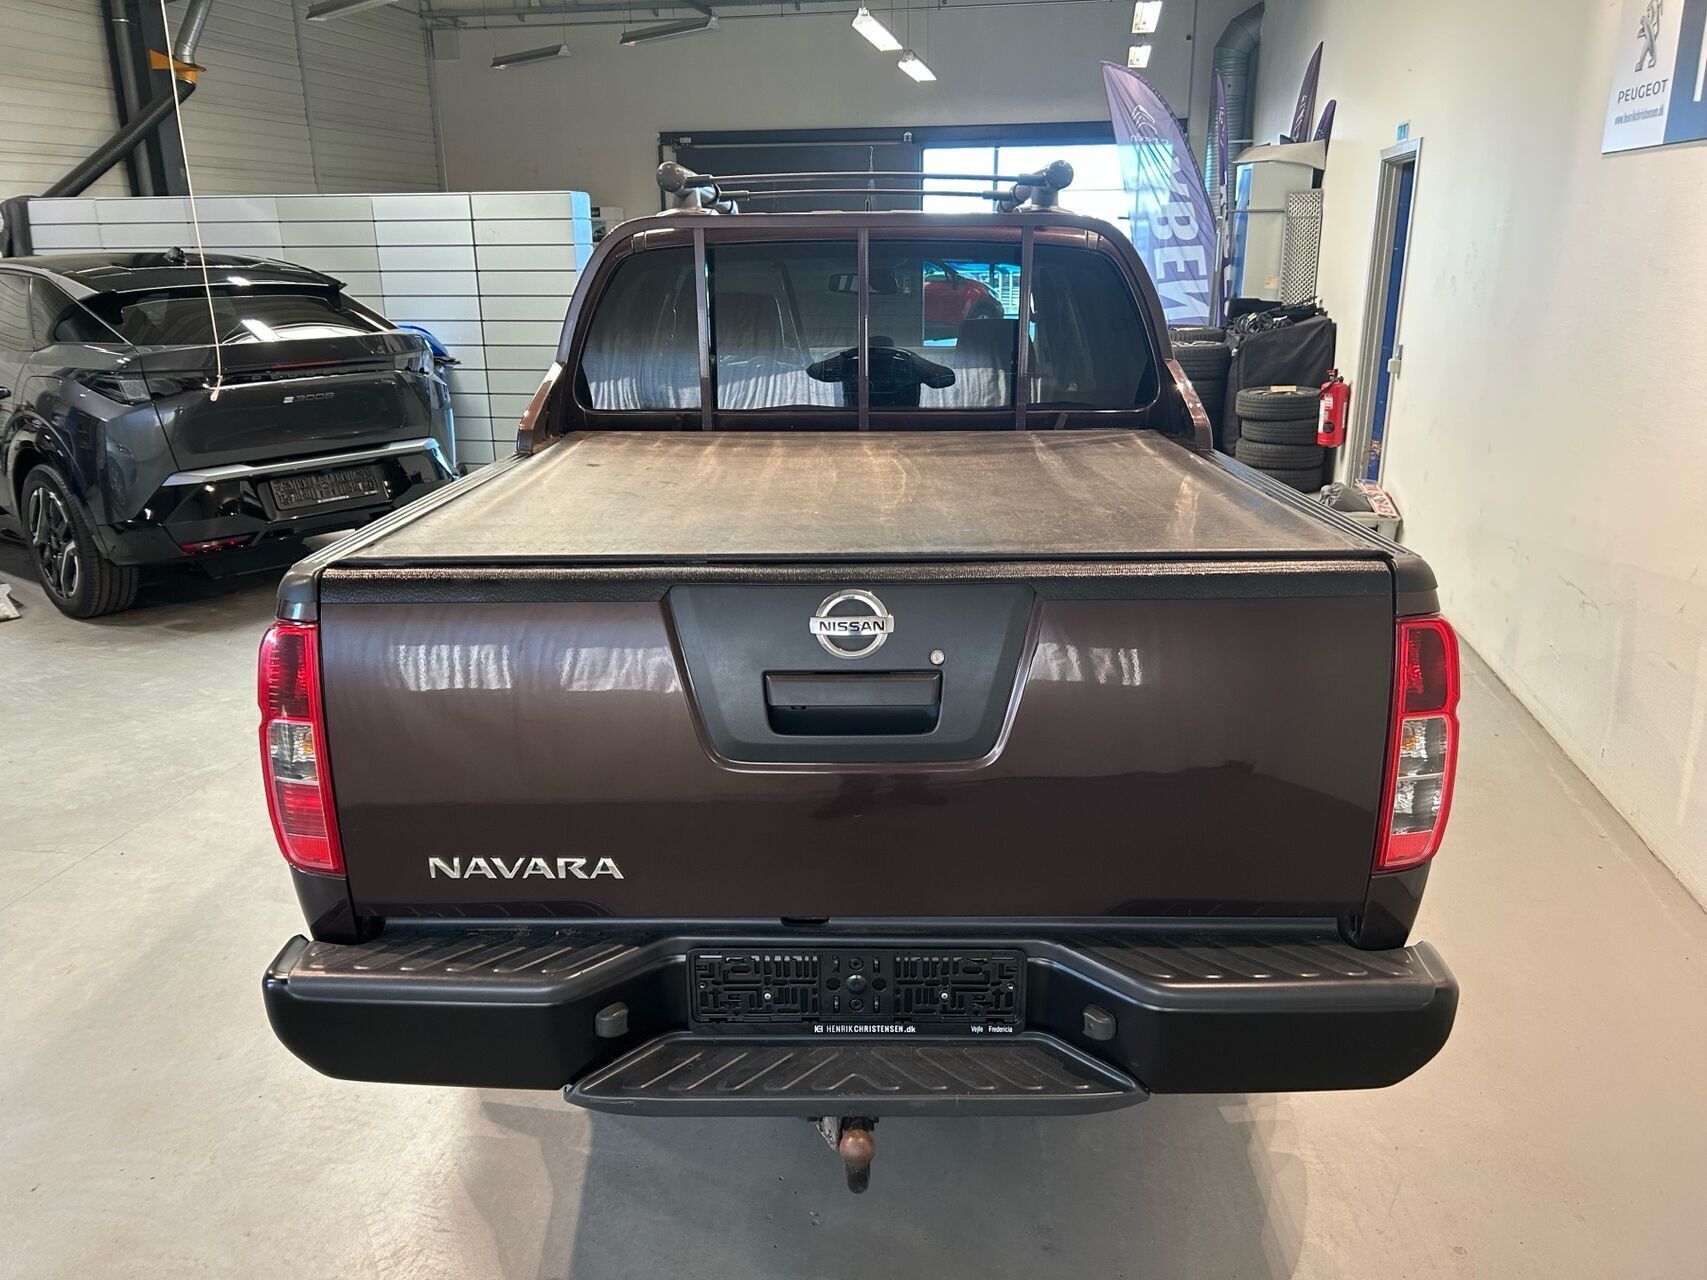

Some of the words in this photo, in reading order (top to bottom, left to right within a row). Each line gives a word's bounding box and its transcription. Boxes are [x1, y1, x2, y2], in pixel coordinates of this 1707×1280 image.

[1617, 79, 1668, 103] PEUGEOT
[819, 620, 885, 632] NISSAN
[428, 857, 625, 879] NAVARA
[826, 1024, 916, 1033] HENRIKCHRISTENSEN.dk
